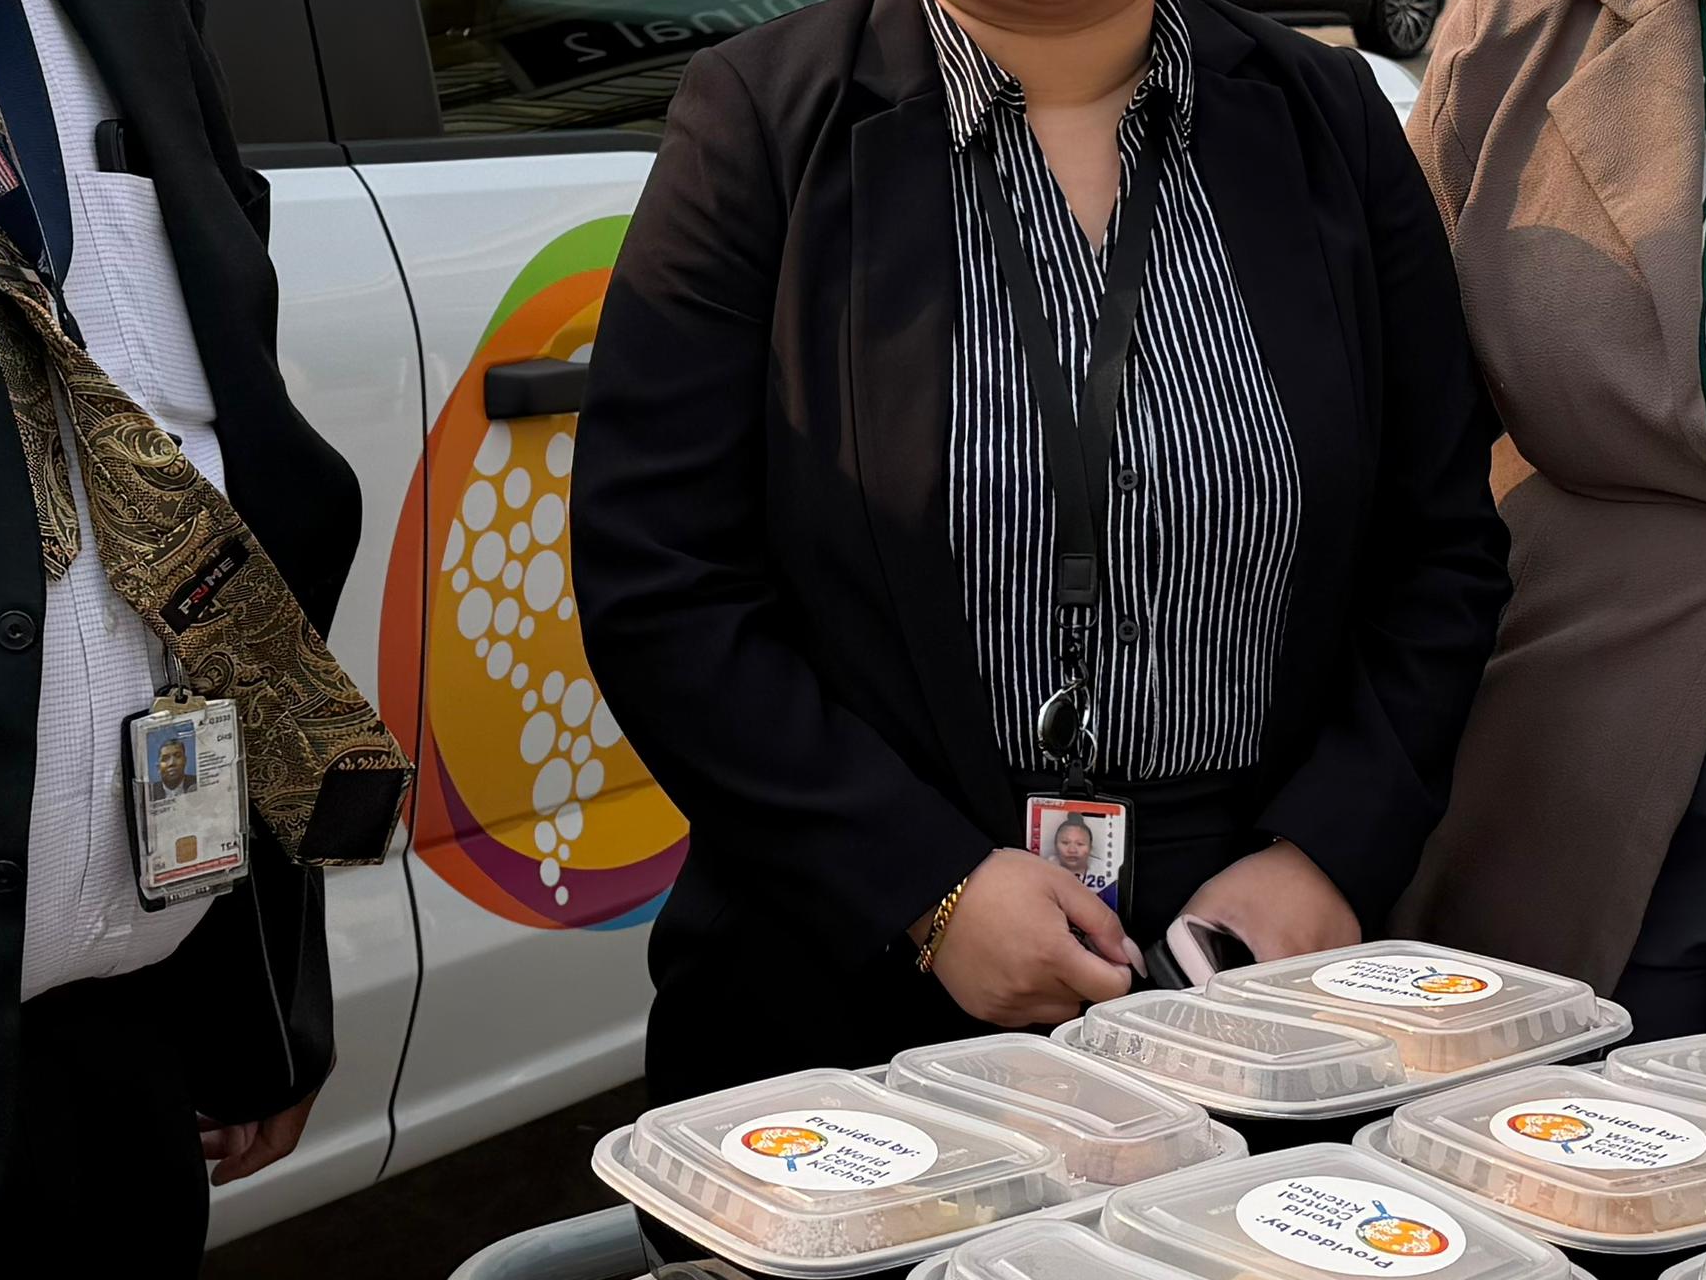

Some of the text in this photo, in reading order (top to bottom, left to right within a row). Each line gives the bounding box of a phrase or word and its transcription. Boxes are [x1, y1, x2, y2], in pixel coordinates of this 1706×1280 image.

[803, 1116, 893, 1147] Provided
[1560, 1103, 1657, 1133] Provided
[1594, 1138, 1667, 1160] Central
[1605, 1131, 1663, 1150] World
[821, 1153, 891, 1178] Central
[835, 1145, 891, 1167] World
[1581, 1143, 1655, 1167] Kitchen
[805, 1159, 876, 1186] Kitchen
[1275, 1190, 1353, 1220] Central
[1287, 1181, 1366, 1214] Kitchen
[1280, 1203, 1342, 1230] World
[1255, 1214, 1394, 1269] Provided by:
